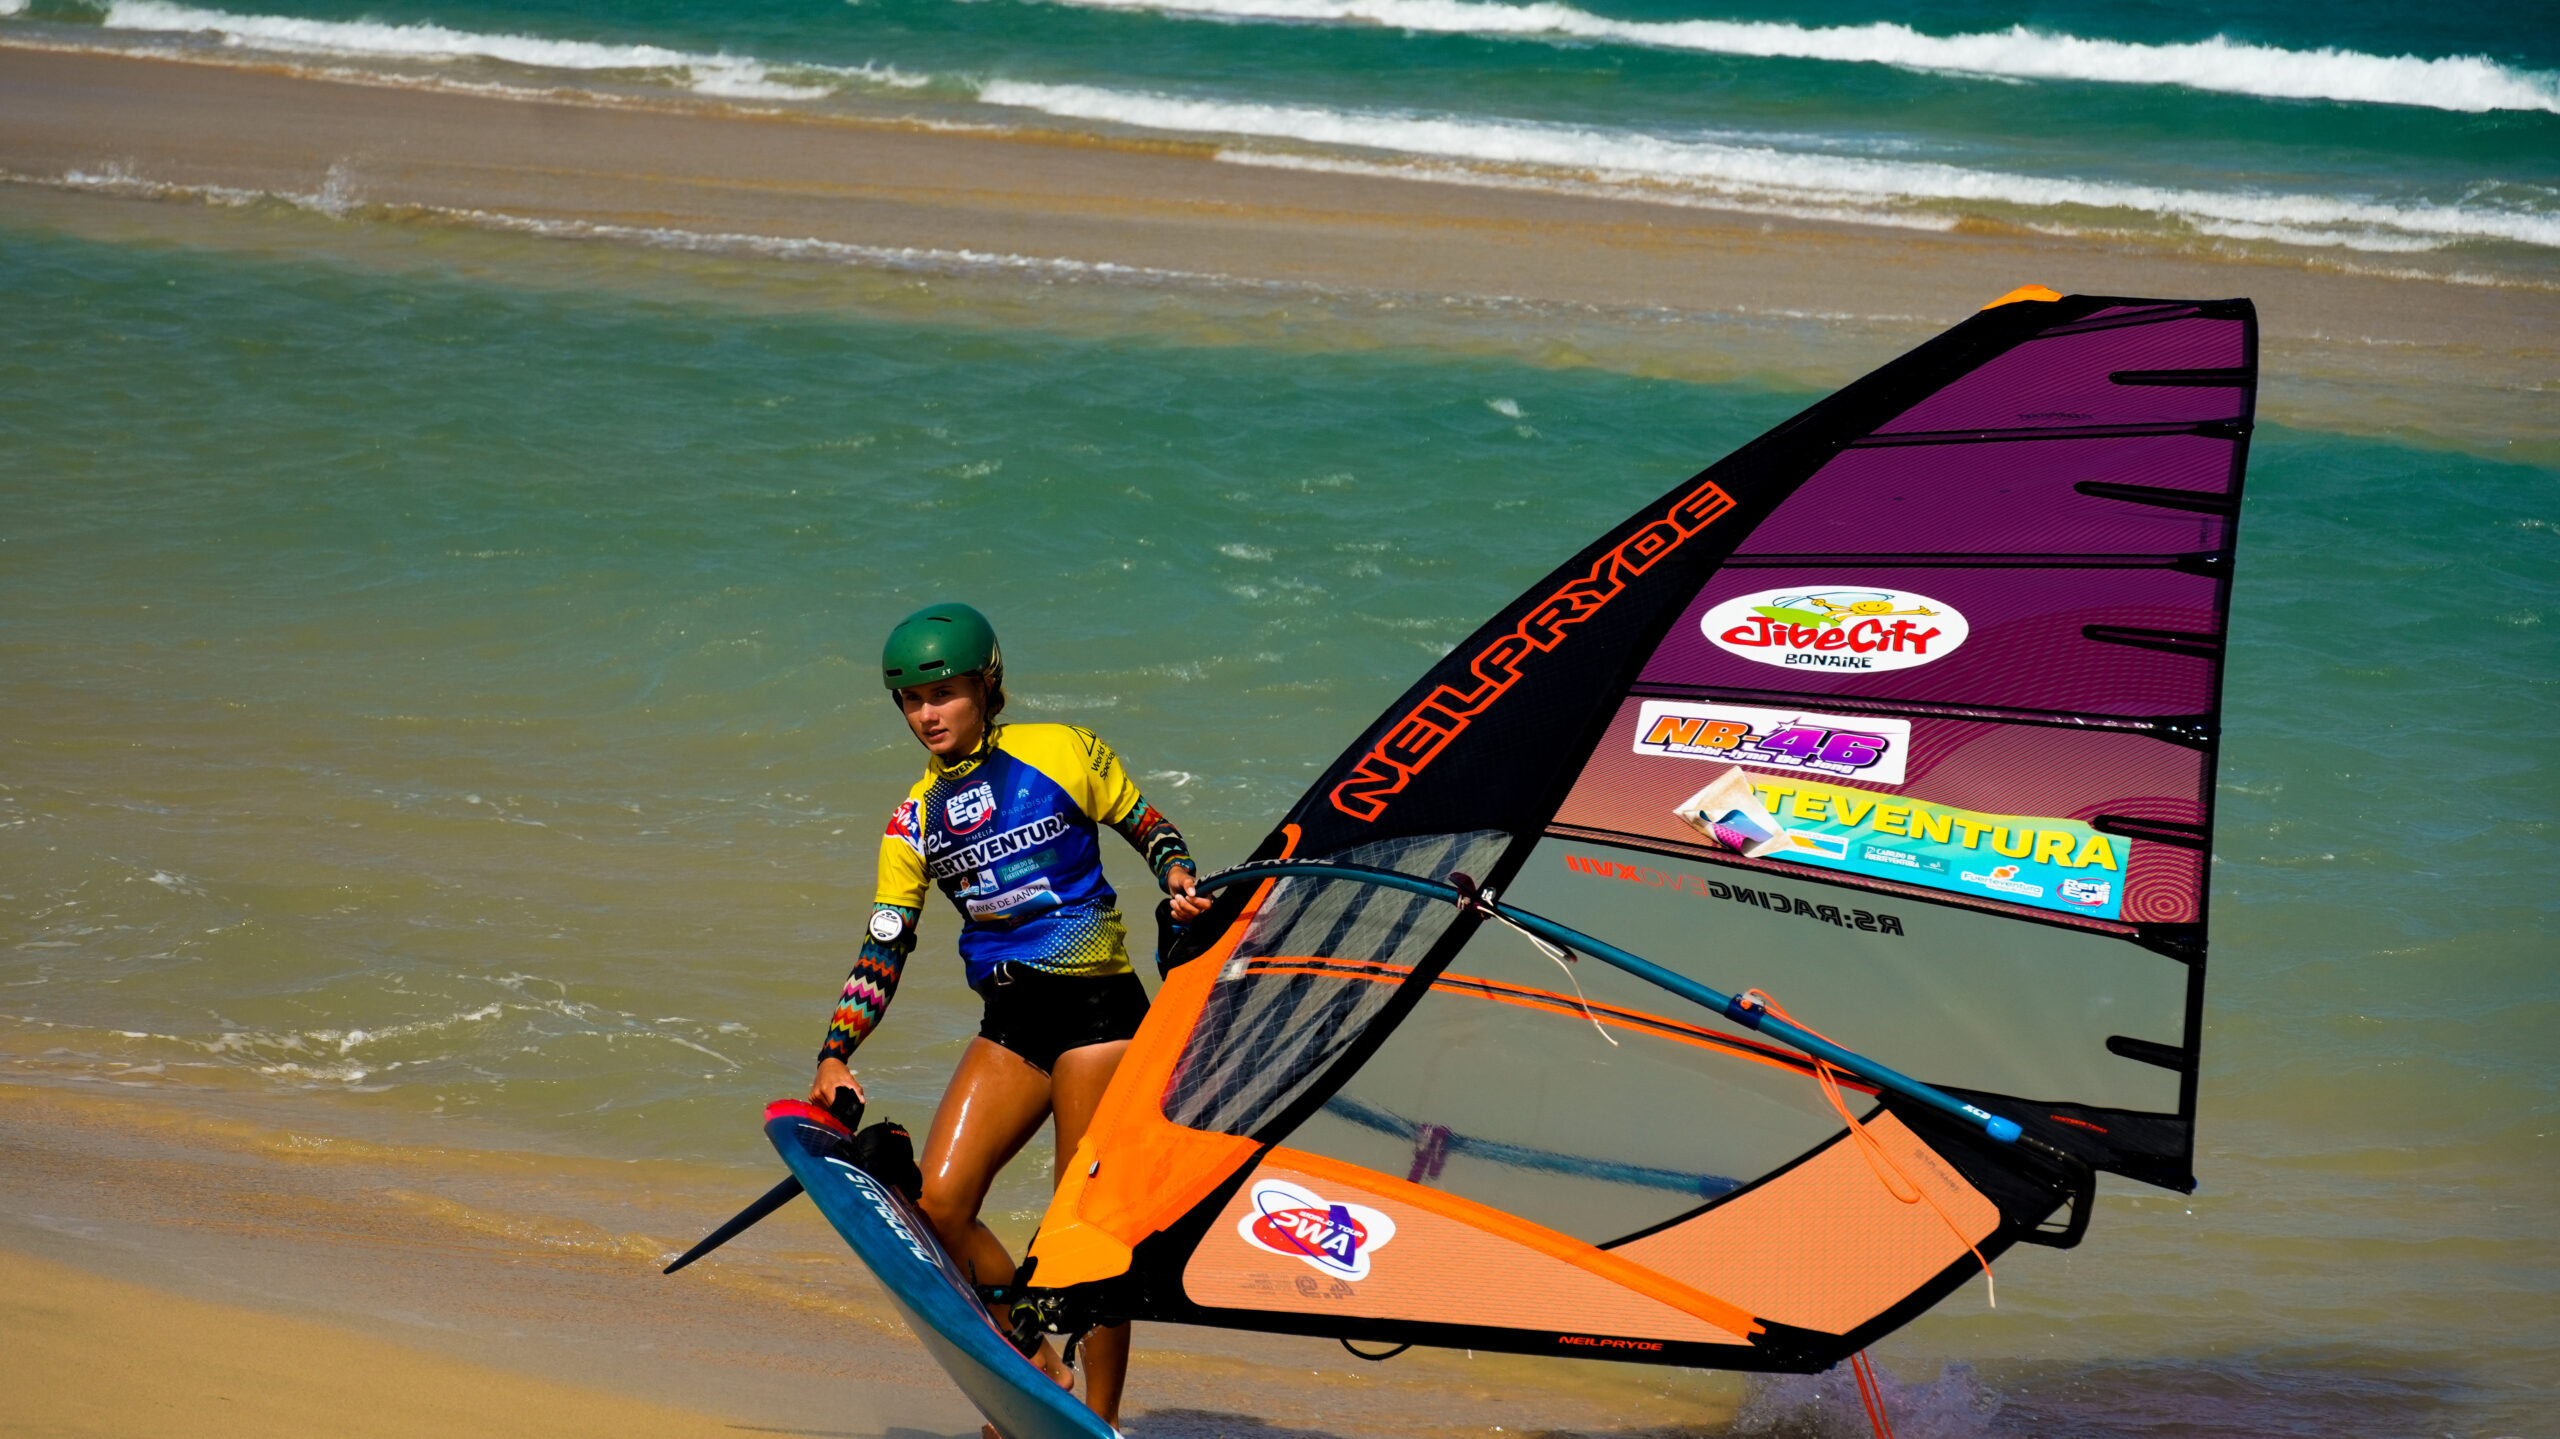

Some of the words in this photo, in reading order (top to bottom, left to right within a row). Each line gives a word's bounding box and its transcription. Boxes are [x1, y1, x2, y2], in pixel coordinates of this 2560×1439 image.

[1329, 480, 1737, 822] NEILPRYDE
[1643, 715, 1888, 767] NB-46
[947, 782, 992, 809] René
[948, 794, 997, 826] Egli
[930, 812, 1069, 879] ERTEVENTURA
[1751, 783, 2118, 871] TEVENTURA
[969, 901, 996, 913] PLAYAS
[997, 898, 1012, 910] DE
[1268, 1211, 1351, 1257] PWA
[1299, 1210, 1335, 1227] WORLD
[1338, 1224, 1364, 1238] TOUR
[1558, 1335, 1664, 1351] NEILPRYDE
